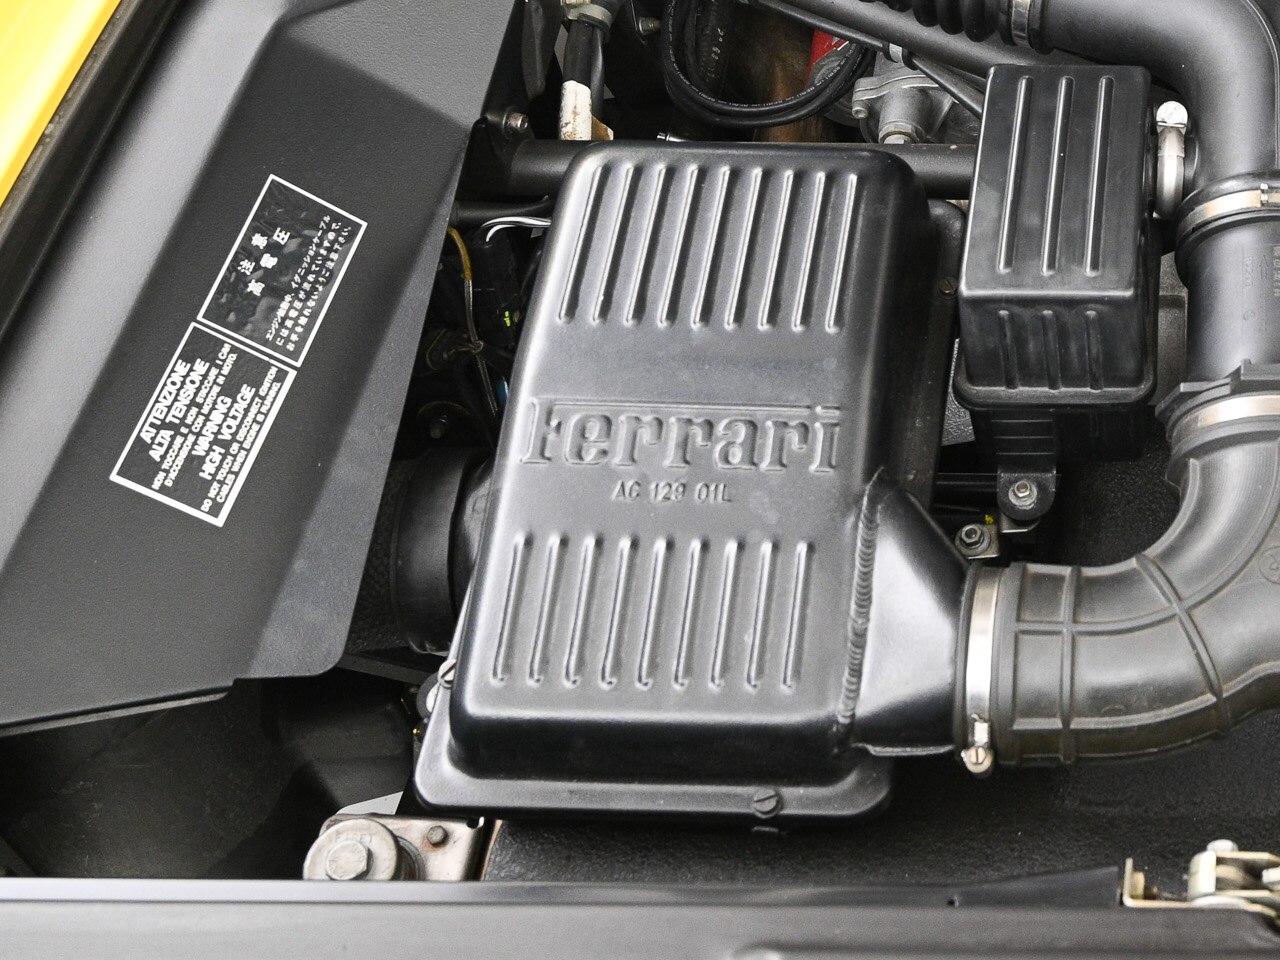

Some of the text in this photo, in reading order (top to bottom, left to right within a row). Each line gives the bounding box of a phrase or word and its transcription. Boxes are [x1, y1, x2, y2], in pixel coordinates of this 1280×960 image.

[139, 359, 191, 444] ATTENZIONE
[148, 358, 210, 462] ALTA TENSIONE
[151, 471, 166, 490] NON
[161, 434, 185, 470] TOCCARE
[184, 406, 199, 425] NON
[195, 366, 220, 404] STACCARE
[191, 414, 206, 433] CON
[200, 384, 222, 415] MOTORE
[191, 395, 233, 456] WARNING
[198, 383, 256, 480] HIGH VOLTAGE
[200, 366, 278, 512] DO NOT TOUCH OR DISCONNECT IGNITION
[521, 396, 842, 473] Ferrari
[216, 473, 236, 503] CABLES
[230, 449, 248, 472] WHEN
[242, 422, 261, 449] ENGINE
[255, 413, 265, 422] IS
[611, 481, 641, 501] AC
[650, 482, 686, 503] 129
